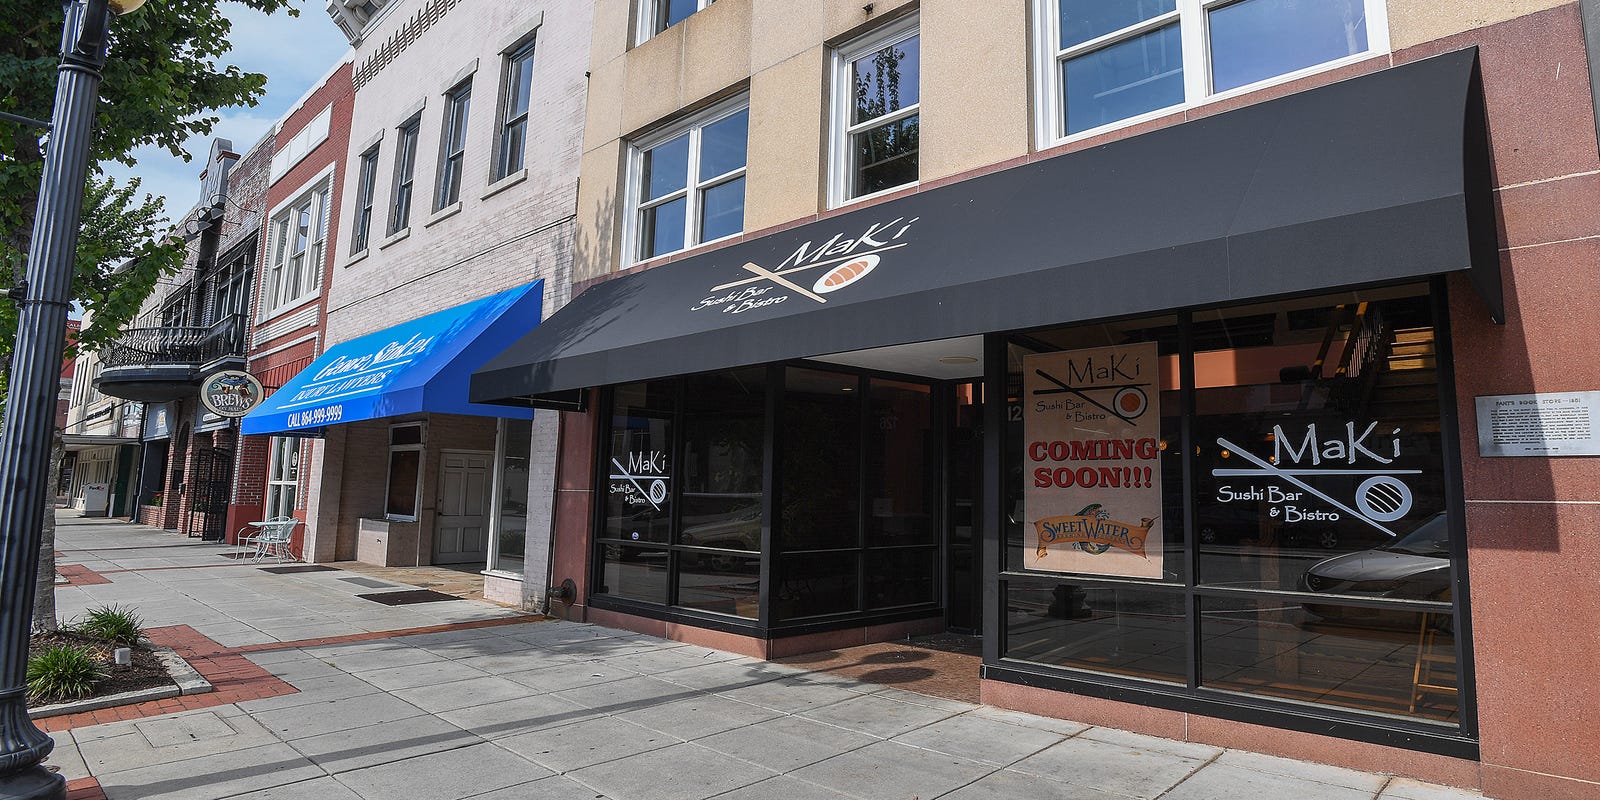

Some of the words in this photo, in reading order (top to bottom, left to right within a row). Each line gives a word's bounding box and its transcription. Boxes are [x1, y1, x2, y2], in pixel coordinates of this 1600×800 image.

[774, 216, 920, 272] MaKi
[690, 291, 741, 312] Sushi
[736, 286, 774, 300] Bar
[722, 304, 736, 314] &
[732, 295, 789, 314] Bistro
[1066, 353, 1141, 386] MaKi
[324, 370, 393, 394] LAWYERS
[211, 393, 253, 409] BREWS
[1035, 400, 1064, 413] Sushi
[1064, 398, 1086, 411] Bar
[287, 412, 302, 428] CALL
[301, 405, 343, 426] 864-999-9999
[1007, 405, 1023, 422] 12
[1075, 411, 1106, 423] Bistro
[1028, 437, 1159, 462] COMING
[1273, 420, 1401, 466] MaKi
[628, 450, 666, 474] MaKi
[1033, 466, 1152, 489] SOON!!!
[609, 483, 625, 494] Sushi
[624, 484, 636, 494] Bar
[1216, 485, 1264, 502] Sushi
[1267, 486, 1303, 503] Bar
[629, 494, 646, 505] Bistro
[1269, 507, 1280, 518] &
[1284, 506, 1340, 523] Bistro
